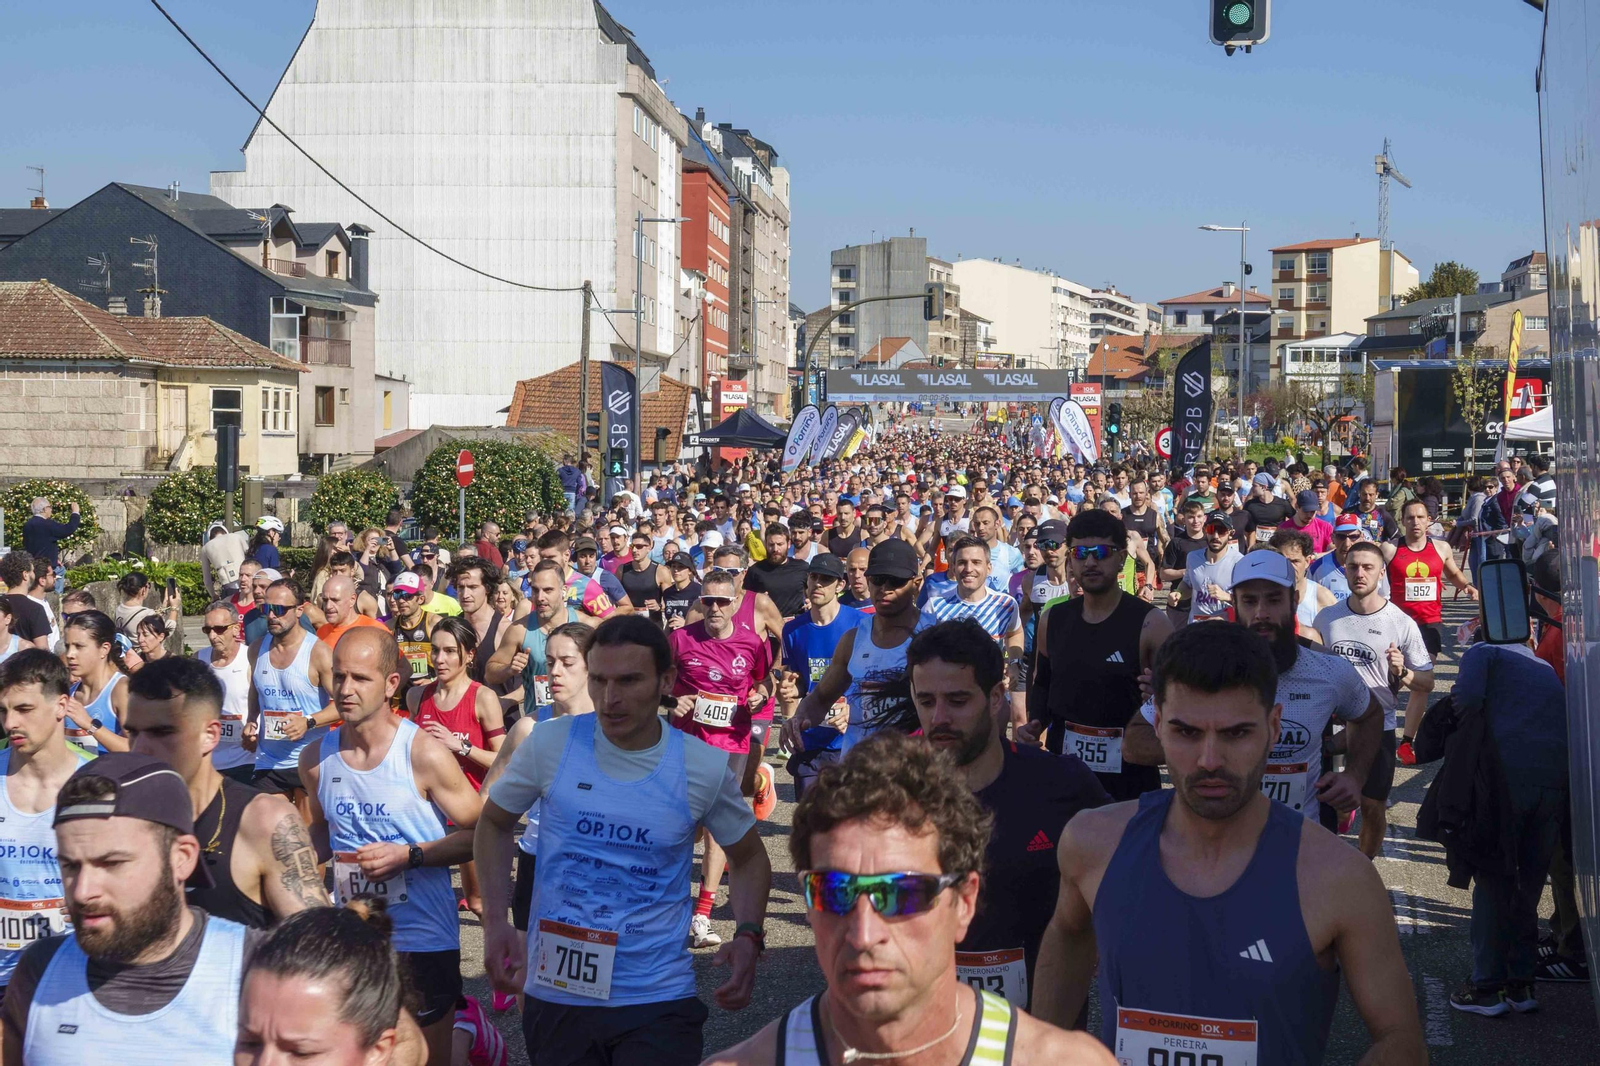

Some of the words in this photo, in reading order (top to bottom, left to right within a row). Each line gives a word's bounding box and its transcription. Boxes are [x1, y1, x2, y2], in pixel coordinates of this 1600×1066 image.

[863, 373, 905, 386] LASAL
[930, 373, 972, 386] LASAL
[996, 373, 1038, 386] LASAL
[1413, 585, 1431, 597] 952
[1333, 645, 1373, 661] GLOBAL
[703, 704, 729, 721] 409
[1075, 739, 1108, 763] 355
[1026, 842, 1054, 852] adidas
[630, 865, 658, 876] GADIS
[556, 944, 599, 984] 705
[1163, 1036, 1208, 1050] PEREIRA
